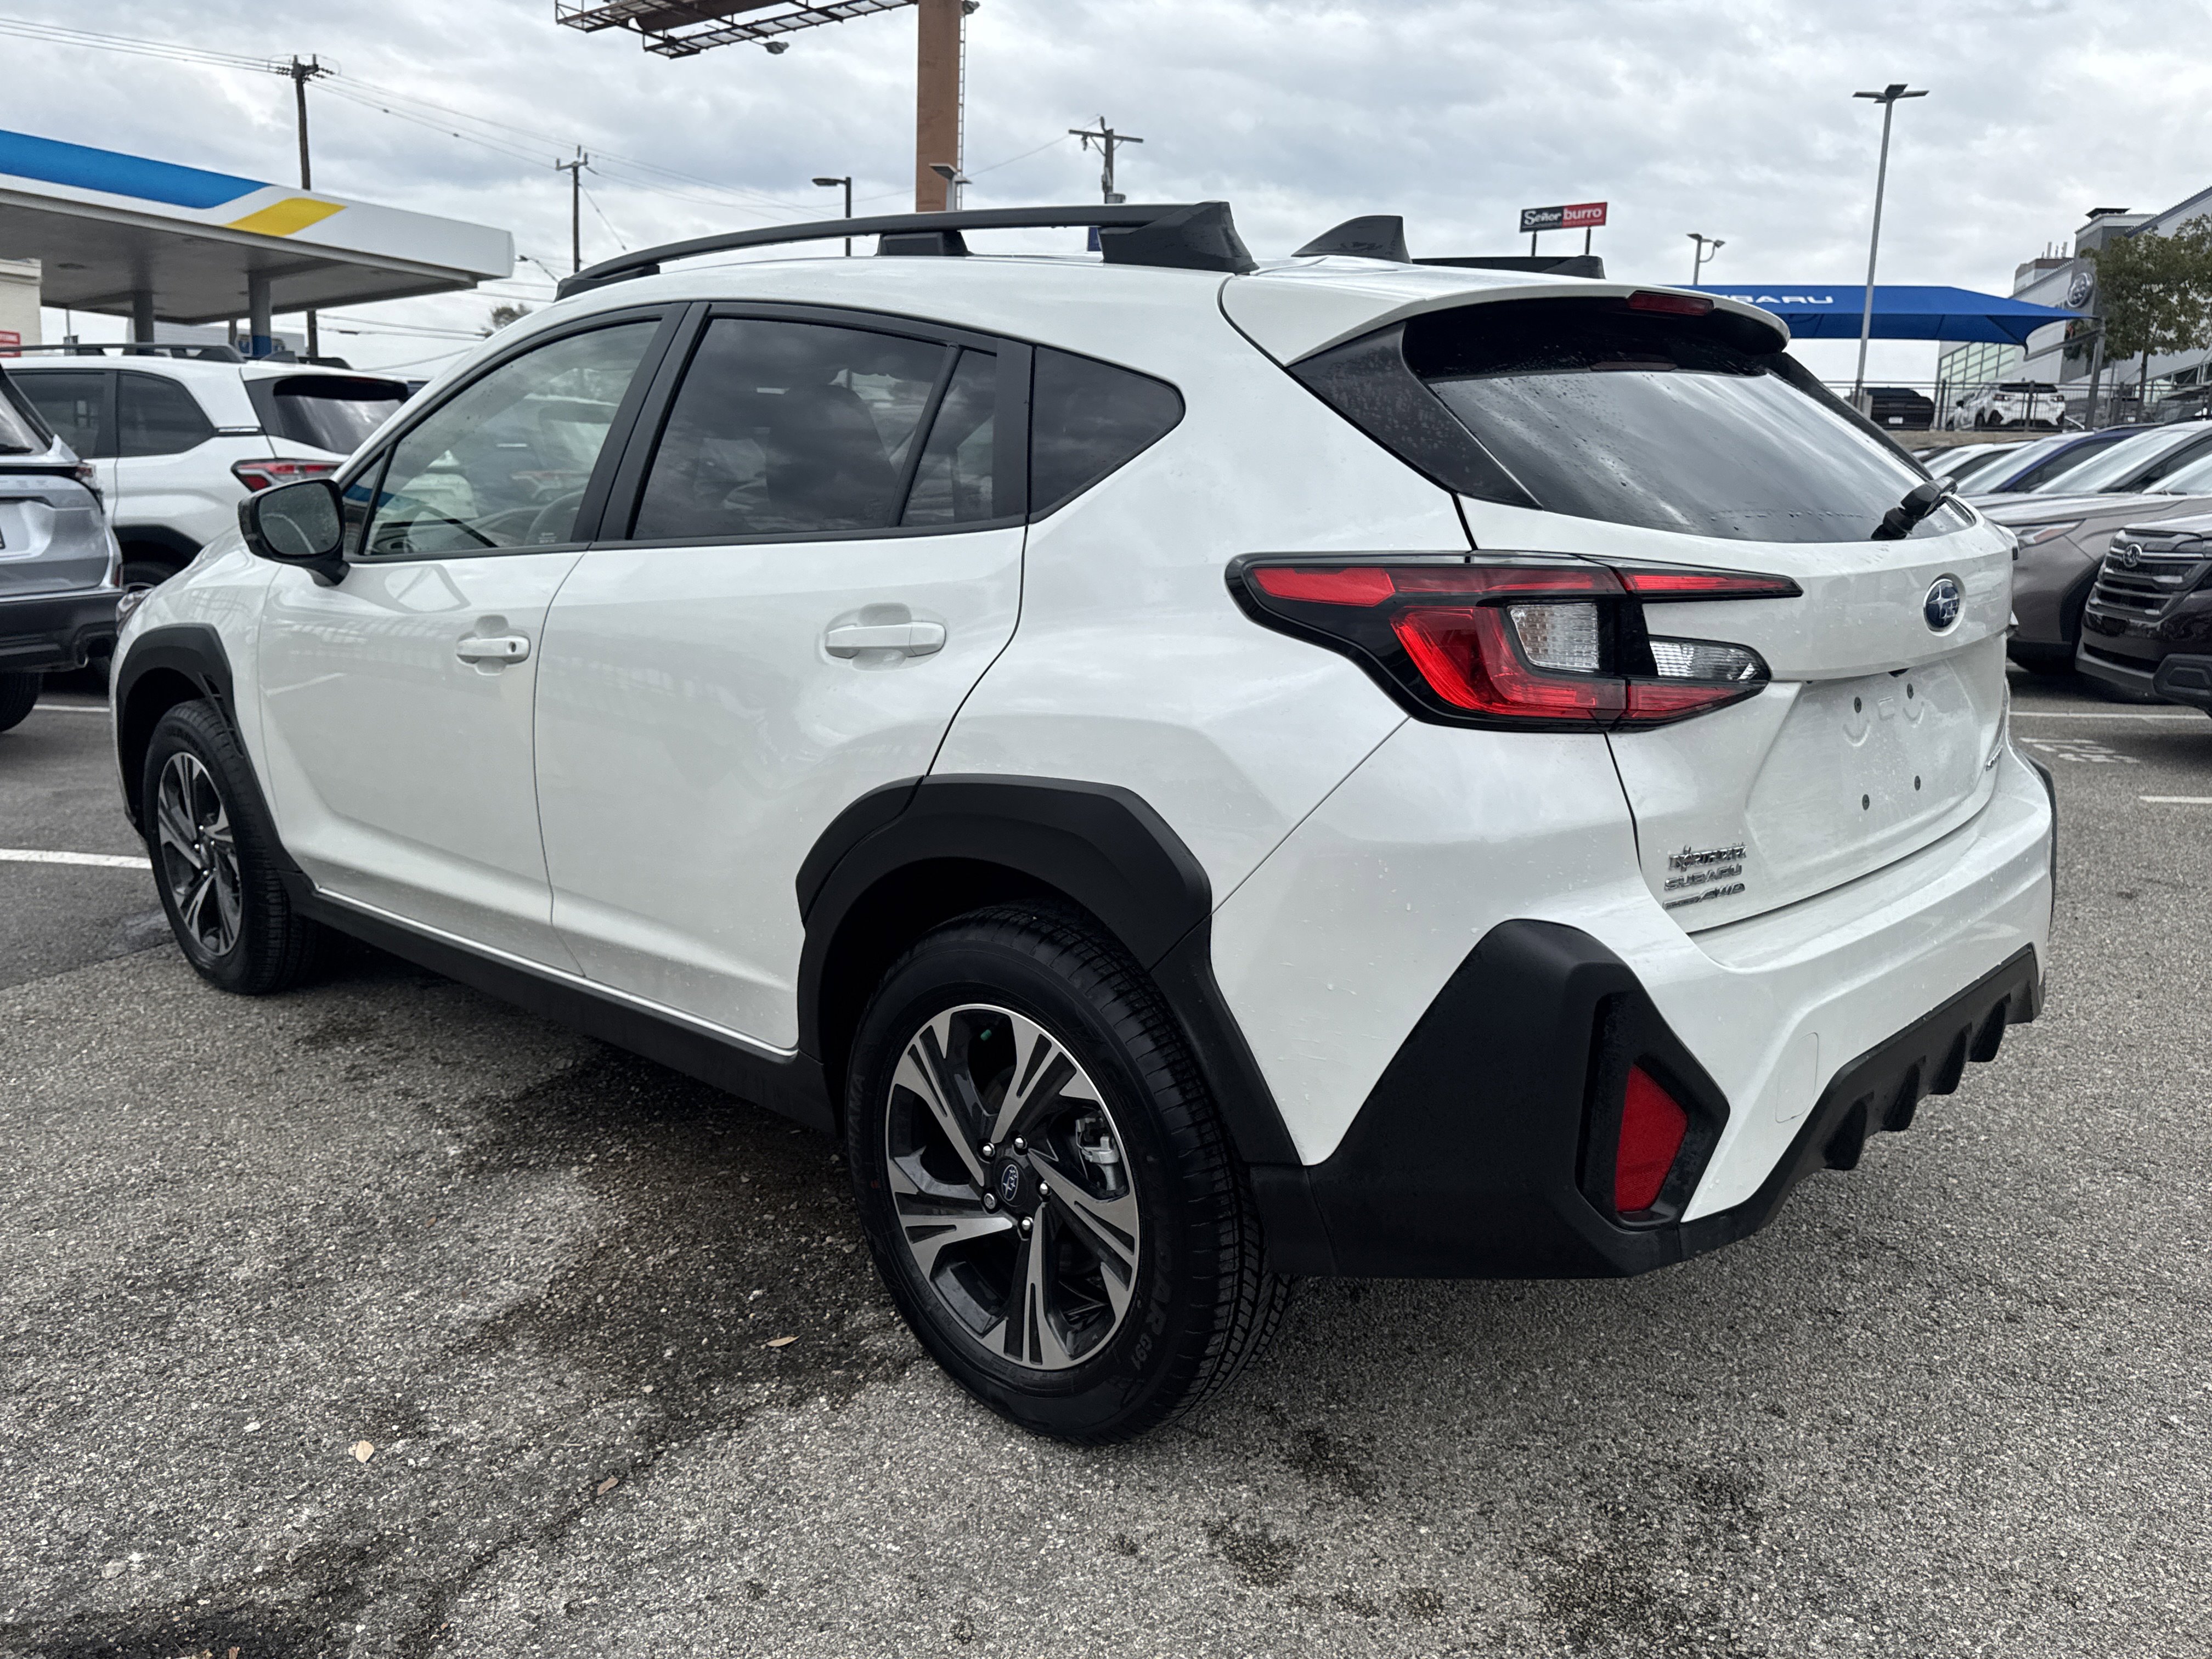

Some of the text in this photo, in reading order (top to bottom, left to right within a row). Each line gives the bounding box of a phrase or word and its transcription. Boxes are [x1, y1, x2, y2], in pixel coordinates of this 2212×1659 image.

[1562, 207, 1602, 221] burro
[1721, 295, 1834, 304] BARU
[1664, 864, 1742, 891] SUBARU
